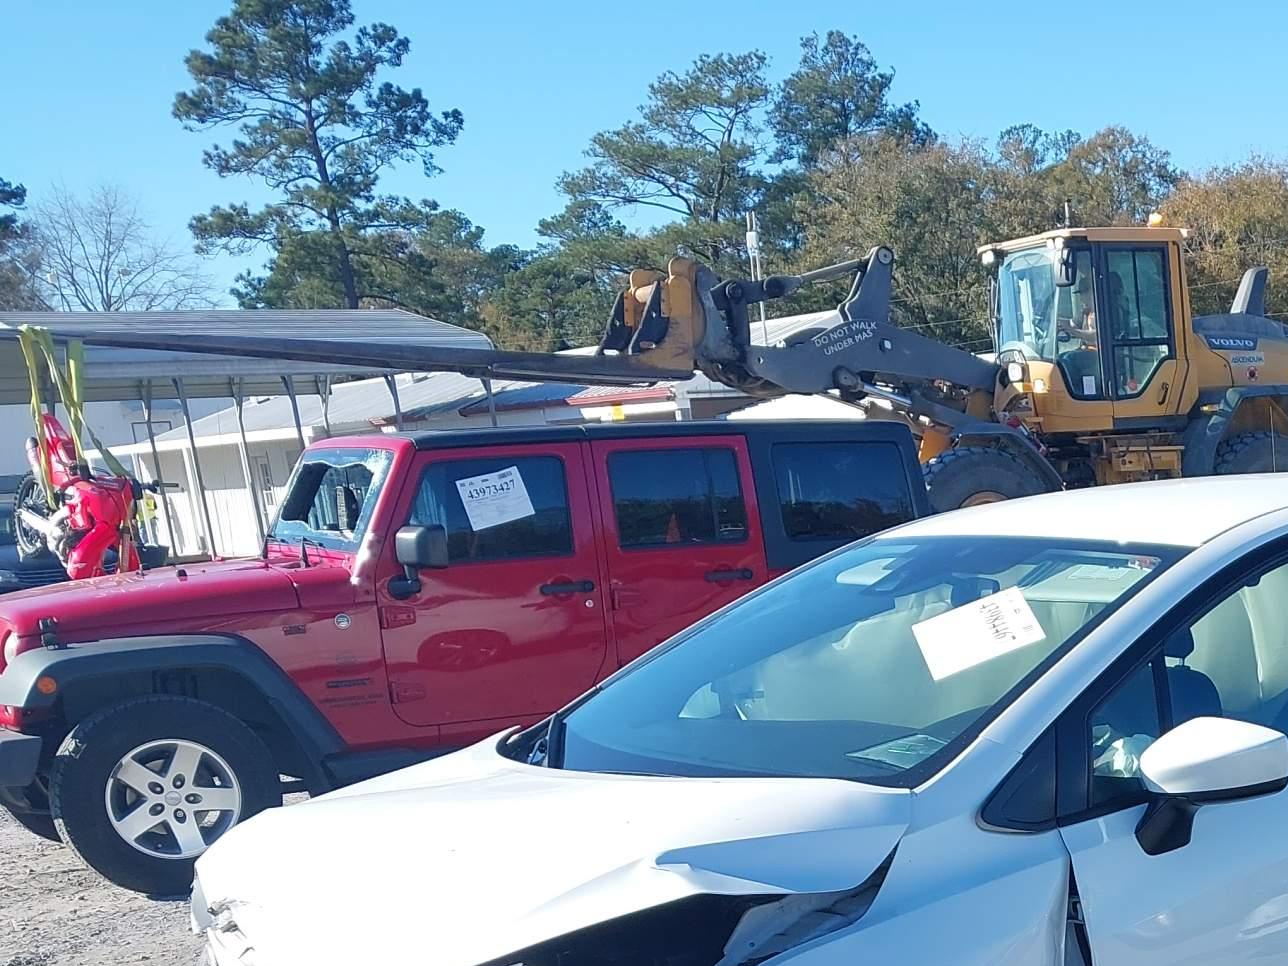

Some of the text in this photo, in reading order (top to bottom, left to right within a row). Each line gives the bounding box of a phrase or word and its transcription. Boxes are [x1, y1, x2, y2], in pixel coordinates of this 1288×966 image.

[814, 321, 877, 347] DO NOT WALK
[1209, 338, 1254, 347] VOLVO
[824, 337, 854, 355] UNDER
[467, 479, 516, 500] 43973427
